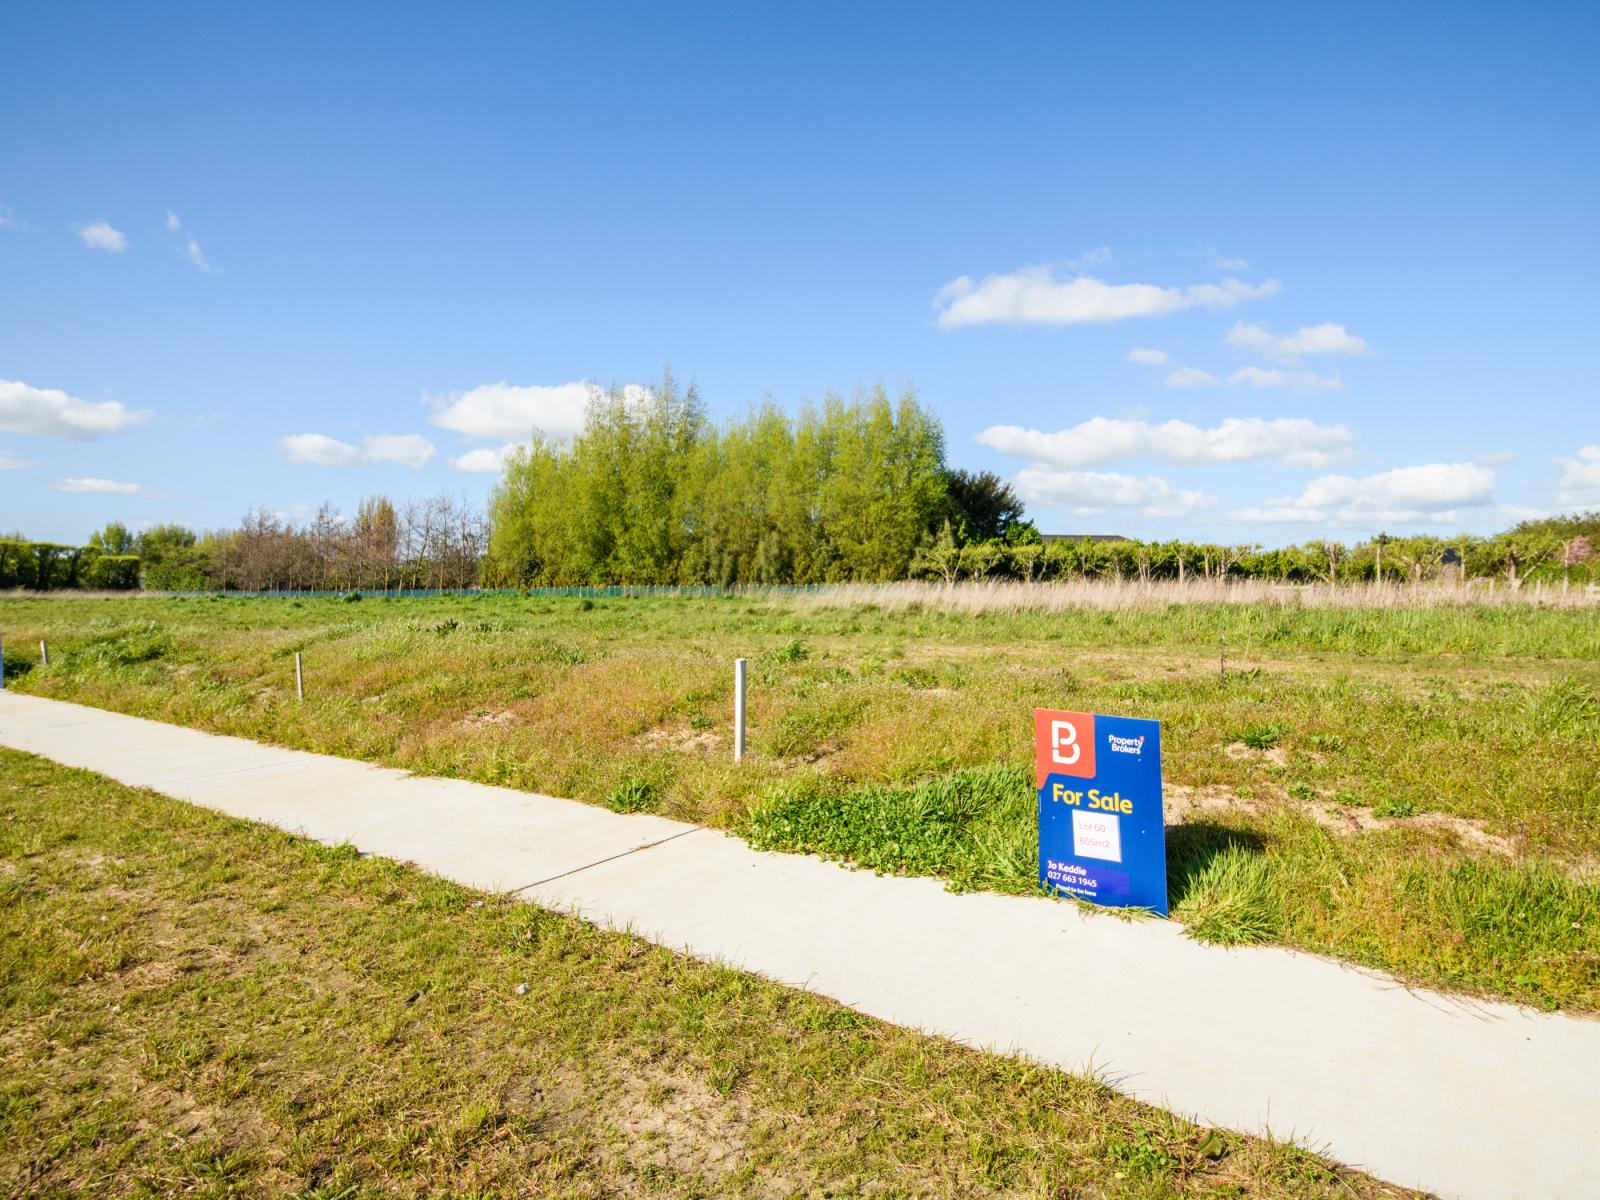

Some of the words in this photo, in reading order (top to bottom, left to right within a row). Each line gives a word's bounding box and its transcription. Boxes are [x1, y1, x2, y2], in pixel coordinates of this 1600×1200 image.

[1108, 735, 1143, 748] Property
[1112, 743, 1141, 755] Brokers
[1053, 783, 1083, 806] For
[1087, 789, 1133, 814] Sale
[1079, 822, 1092, 831] Lot
[1047, 860, 1057, 869] Jo
[1058, 863, 1087, 875] Keddie
[1048, 871, 1061, 880] 027
[1062, 874, 1076, 884] 663
[1078, 877, 1097, 887] 1945
